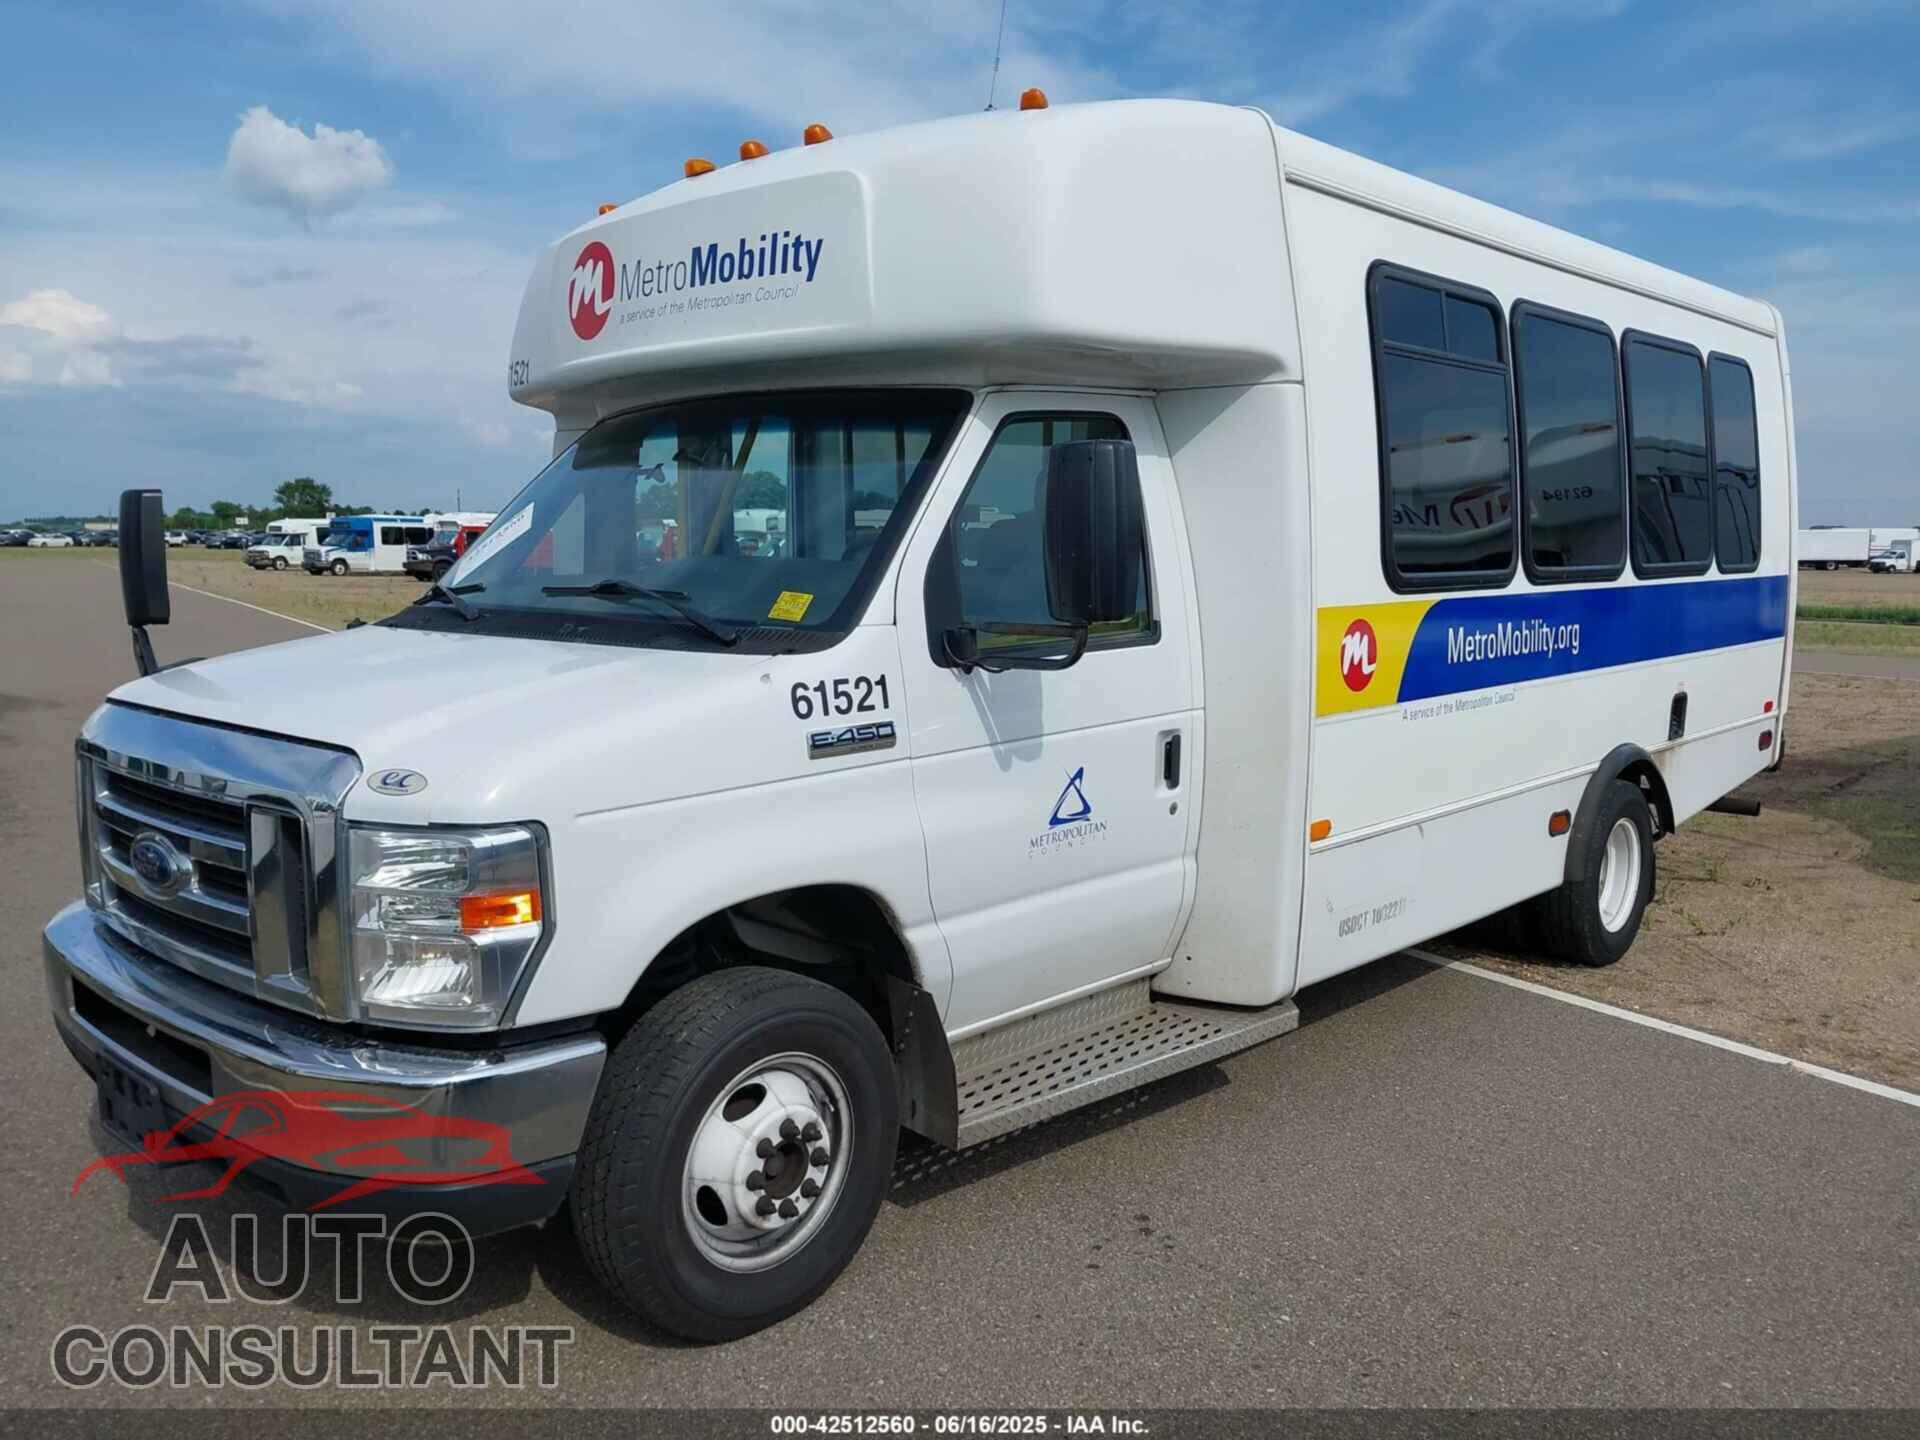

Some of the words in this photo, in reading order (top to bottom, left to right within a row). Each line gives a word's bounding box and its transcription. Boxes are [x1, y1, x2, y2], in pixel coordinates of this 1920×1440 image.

[619, 230, 824, 303] MetroMobility
[626, 308, 656, 323] service
[657, 304, 668, 318] of
[670, 302, 685, 316] the
[688, 292, 753, 311] Metropolitan
[755, 284, 800, 303] Council
[1446, 617, 1581, 665] MetroMobility.org
[790, 673, 890, 720] 61521
[810, 720, 896, 749] E-450
[1029, 819, 1108, 849] METROPOLITAN
